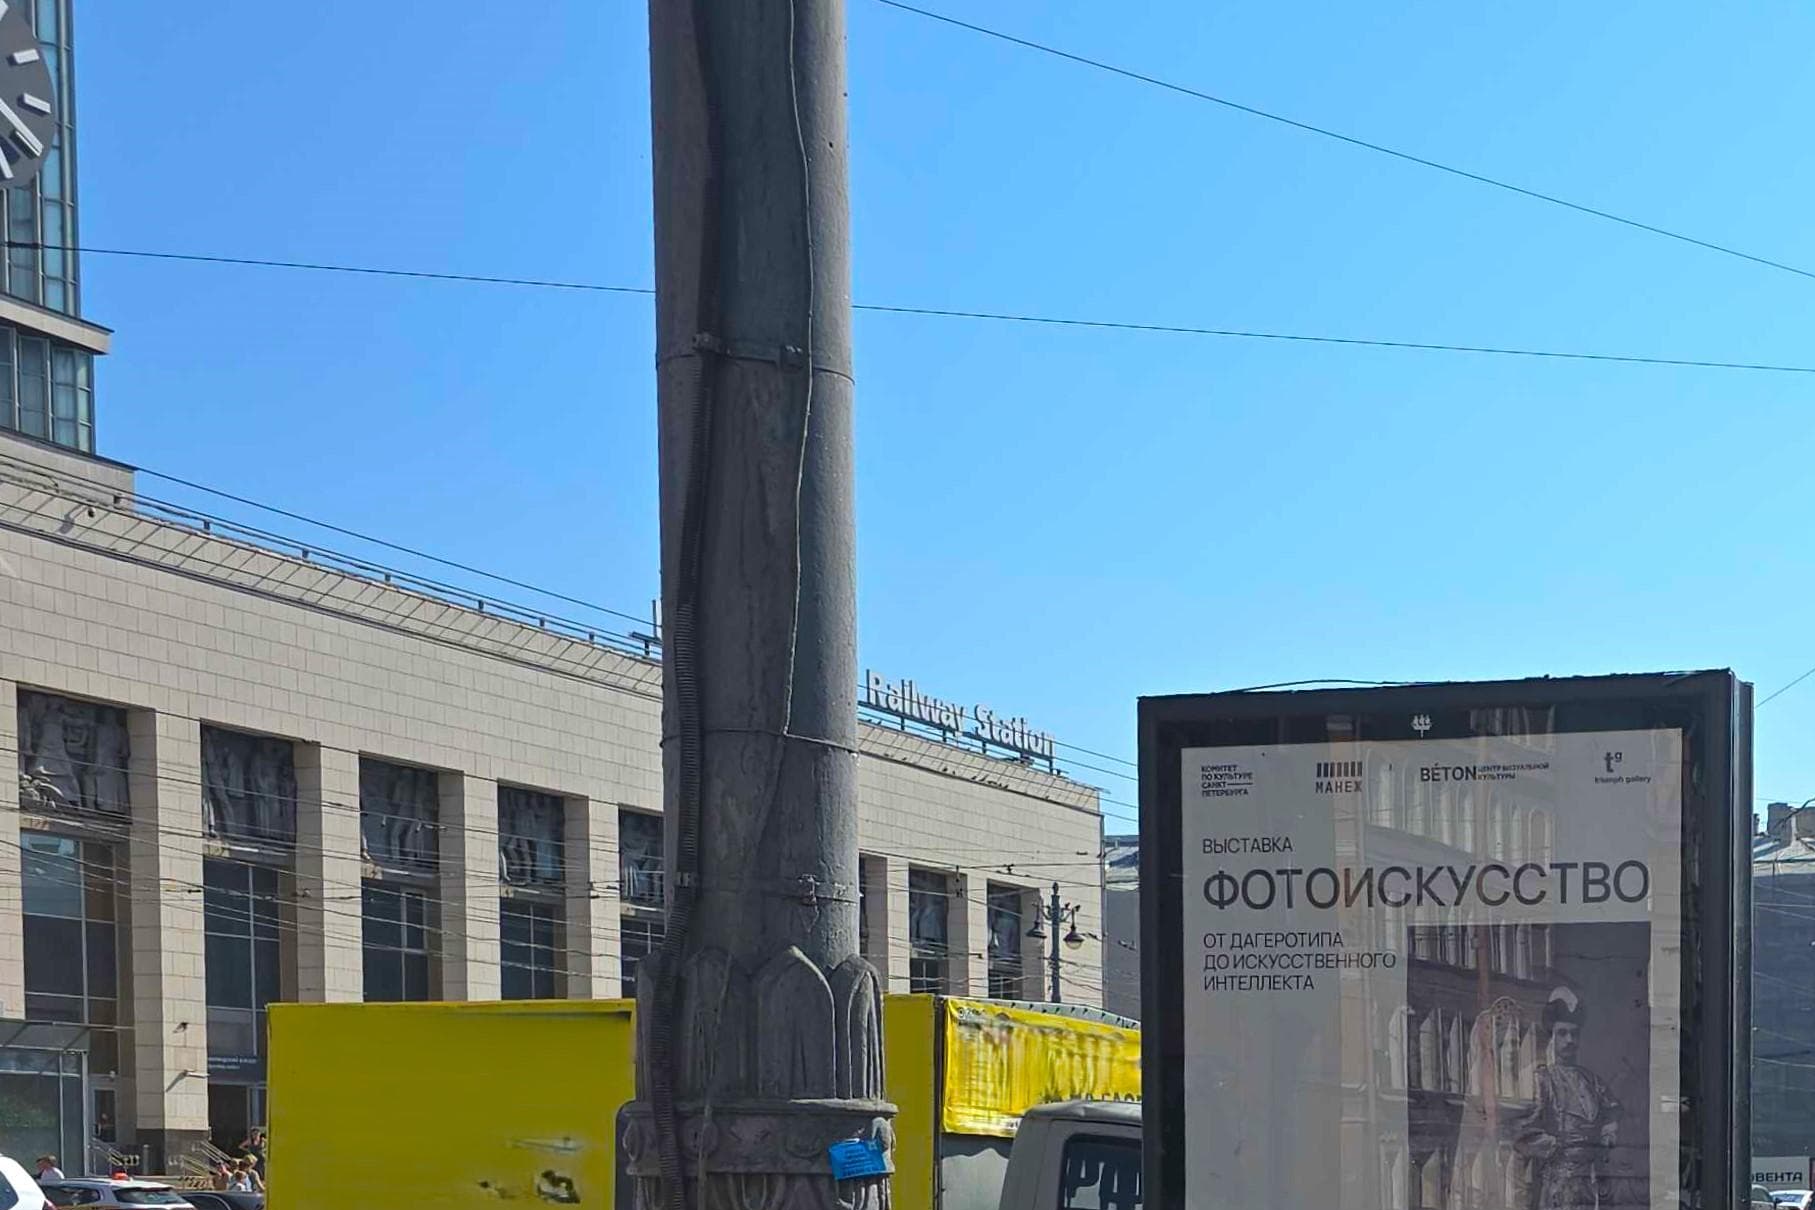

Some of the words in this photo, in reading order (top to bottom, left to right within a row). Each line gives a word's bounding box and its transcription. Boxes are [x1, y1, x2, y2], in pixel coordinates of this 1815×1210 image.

[866, 669, 966, 737] Railway
[975, 704, 1055, 758] Station
[1315, 780, 1363, 794] МАНЕЖ
[1202, 836, 1293, 854] ВЫСТАВКА
[1203, 859, 1650, 910] ФОТОИСКУССТВО
[1203, 932, 1227, 949] ОТ
[1229, 931, 1344, 951] ДАГЕРОТИПА
[1203, 954, 1230, 972] ДО
[1233, 951, 1396, 970] ИСКУССТВЕННОГО
[1204, 974, 1314, 992] ИНТЕЛЛЕКТА
